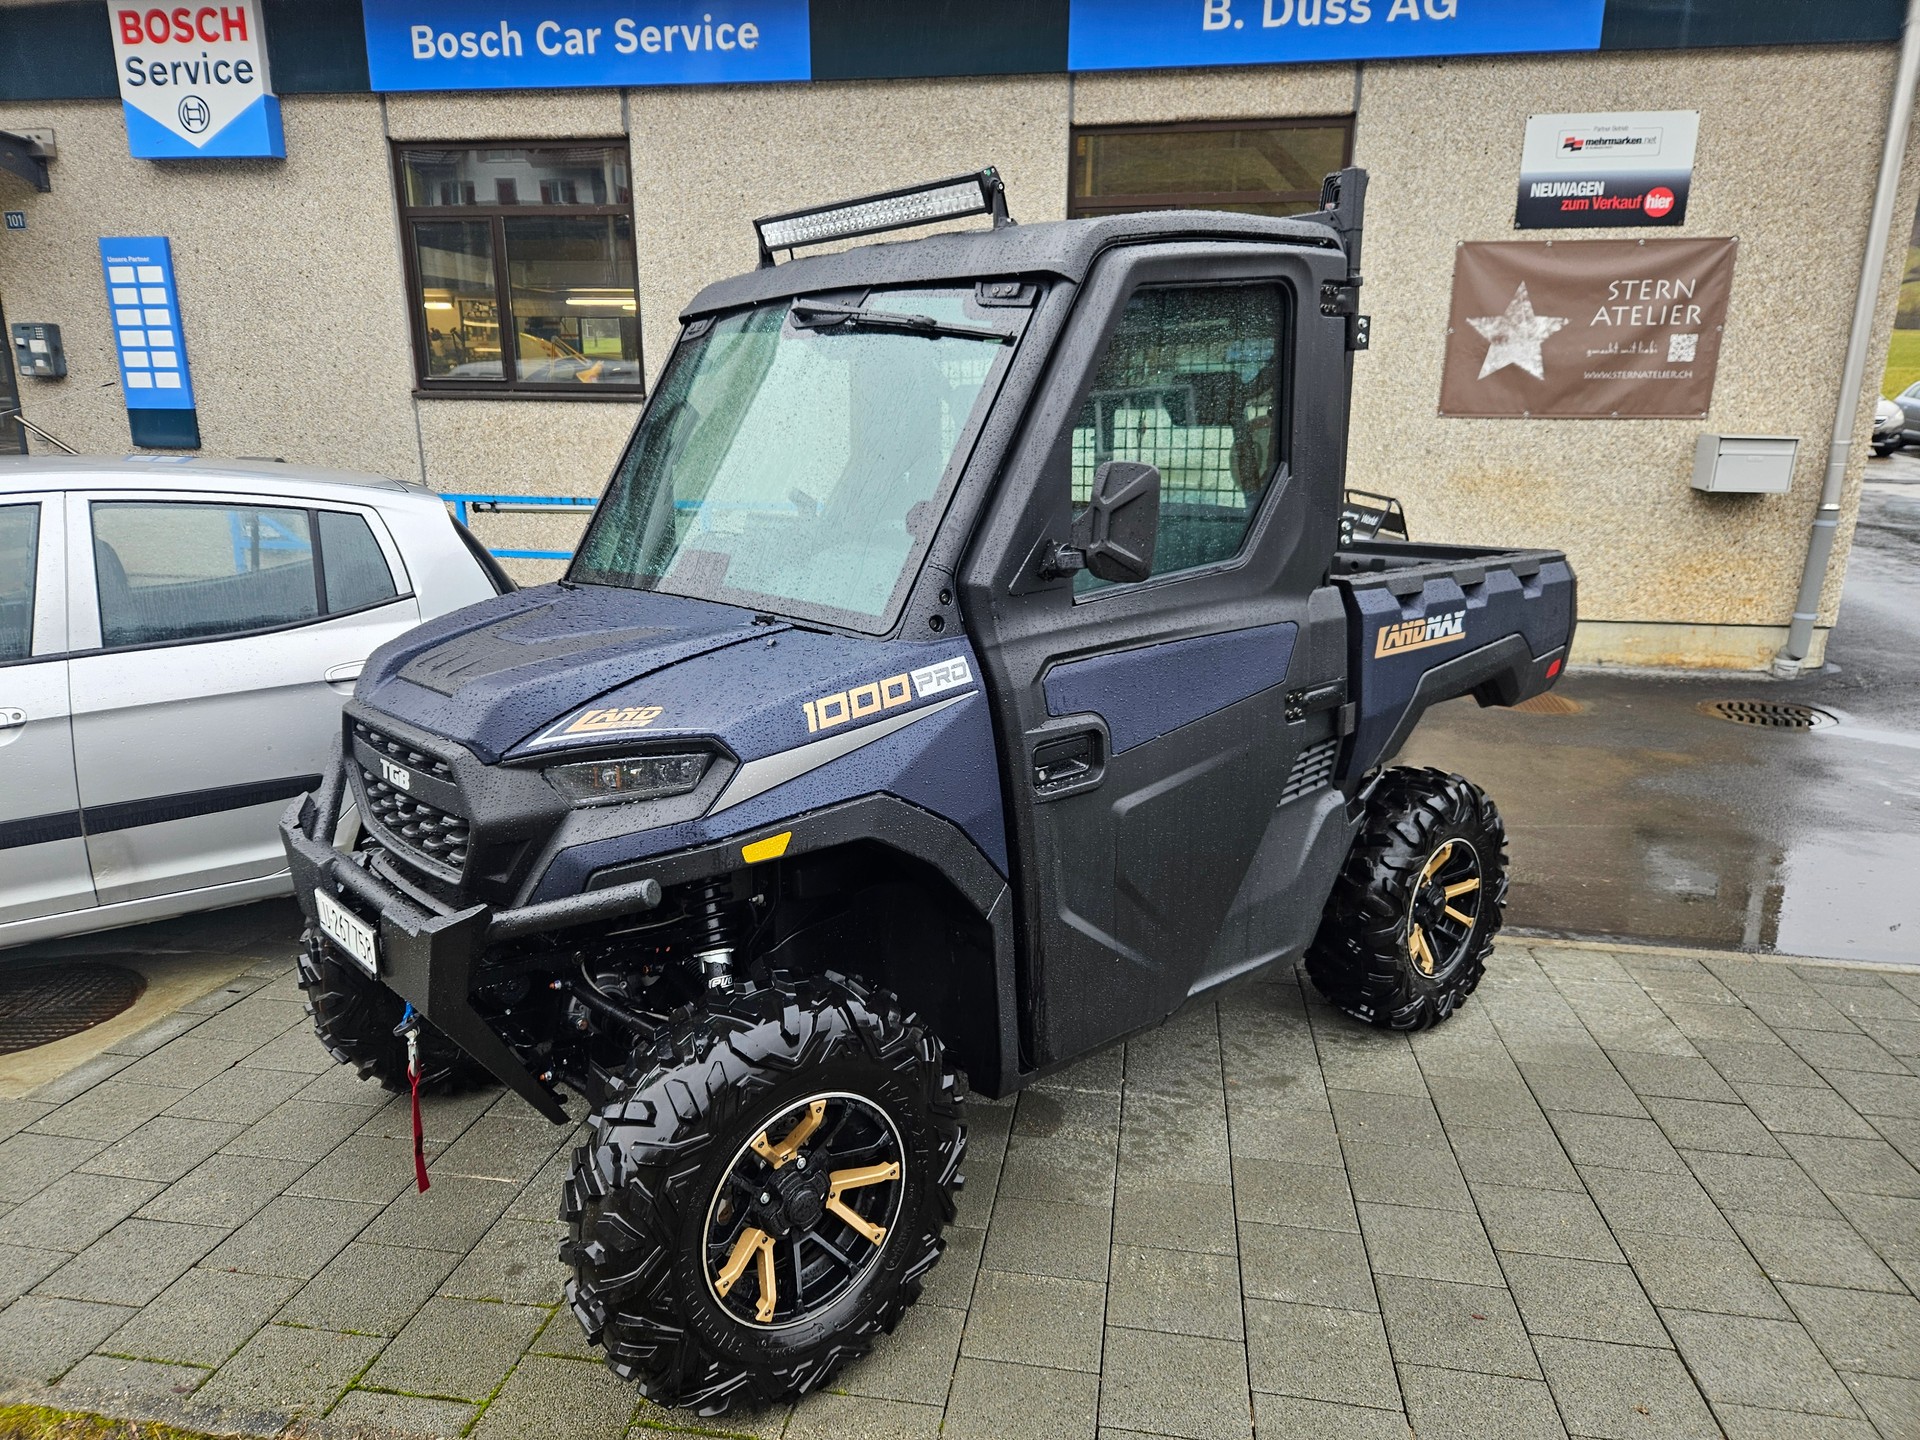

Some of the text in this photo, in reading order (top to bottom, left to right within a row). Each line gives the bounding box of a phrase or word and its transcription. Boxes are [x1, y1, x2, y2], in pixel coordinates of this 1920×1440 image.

[118, 6, 248, 44] BOSCH
[1202, 0, 1458, 31] B. Duss AG
[411, 14, 760, 59] Bosch Car Service
[125, 52, 254, 87] Service
[1530, 181, 1605, 198] NEUWAGEN
[1560, 193, 1673, 211] zum Verkauf hier
[6, 214, 23, 227] 101
[1607, 278, 1697, 301] STERN
[1589, 304, 1702, 327] ATELIER
[1374, 610, 1467, 659] LANDMAX
[802, 661, 969, 733] 1000 PRO
[563, 706, 664, 733] LAND
[380, 758, 410, 791] TGB
